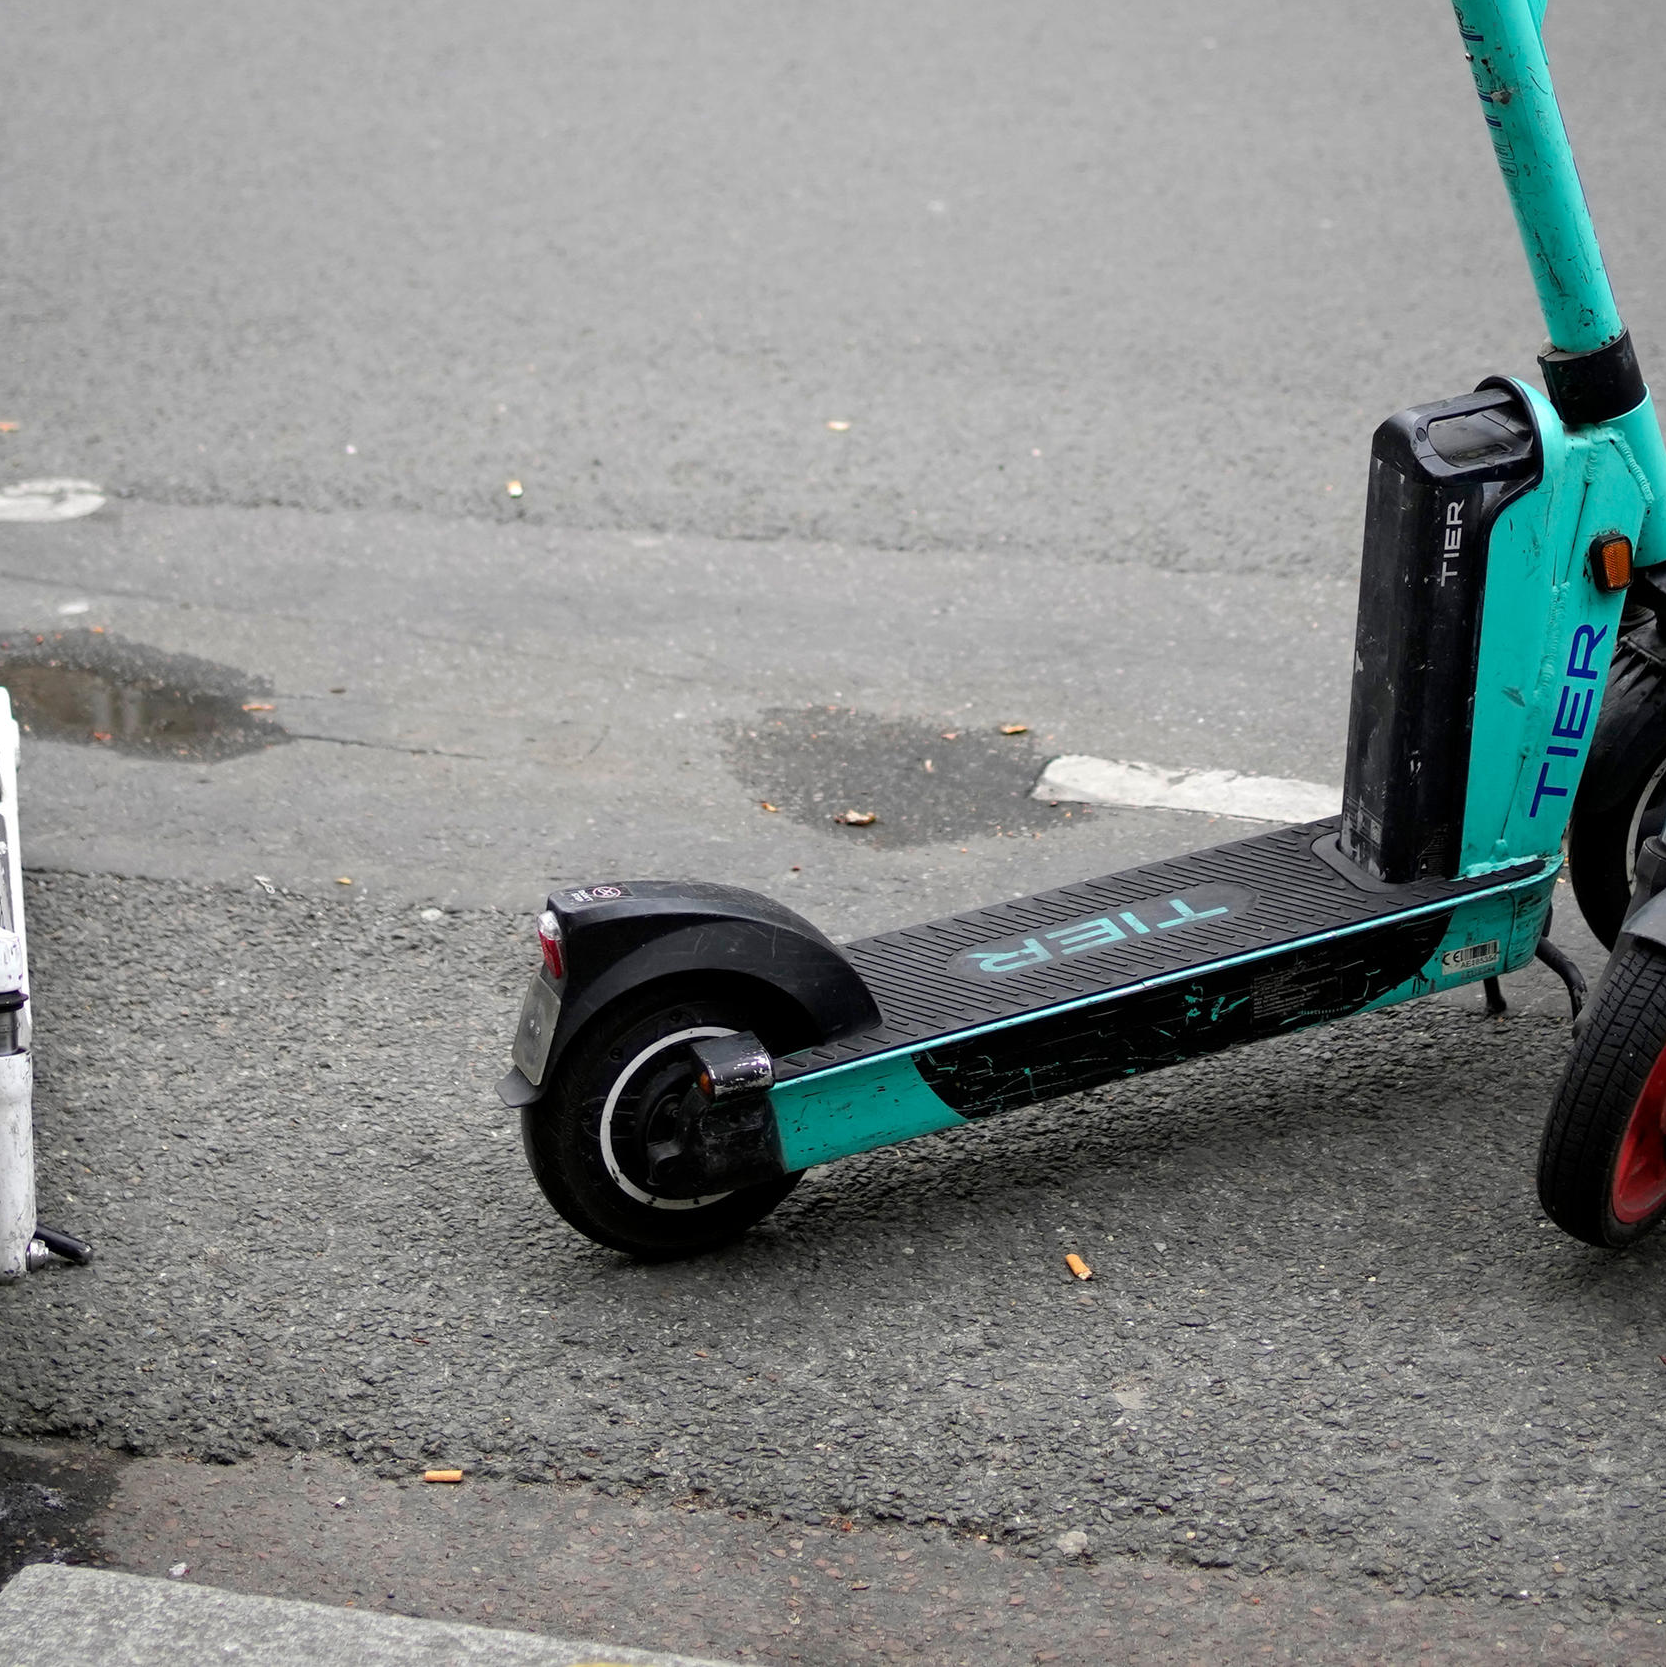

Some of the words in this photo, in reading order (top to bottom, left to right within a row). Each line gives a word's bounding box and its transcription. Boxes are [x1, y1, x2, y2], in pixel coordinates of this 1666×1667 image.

[1441, 498, 1465, 588] TIER
[1529, 623, 1608, 819] TIER
[966, 898, 1229, 973] TIER
